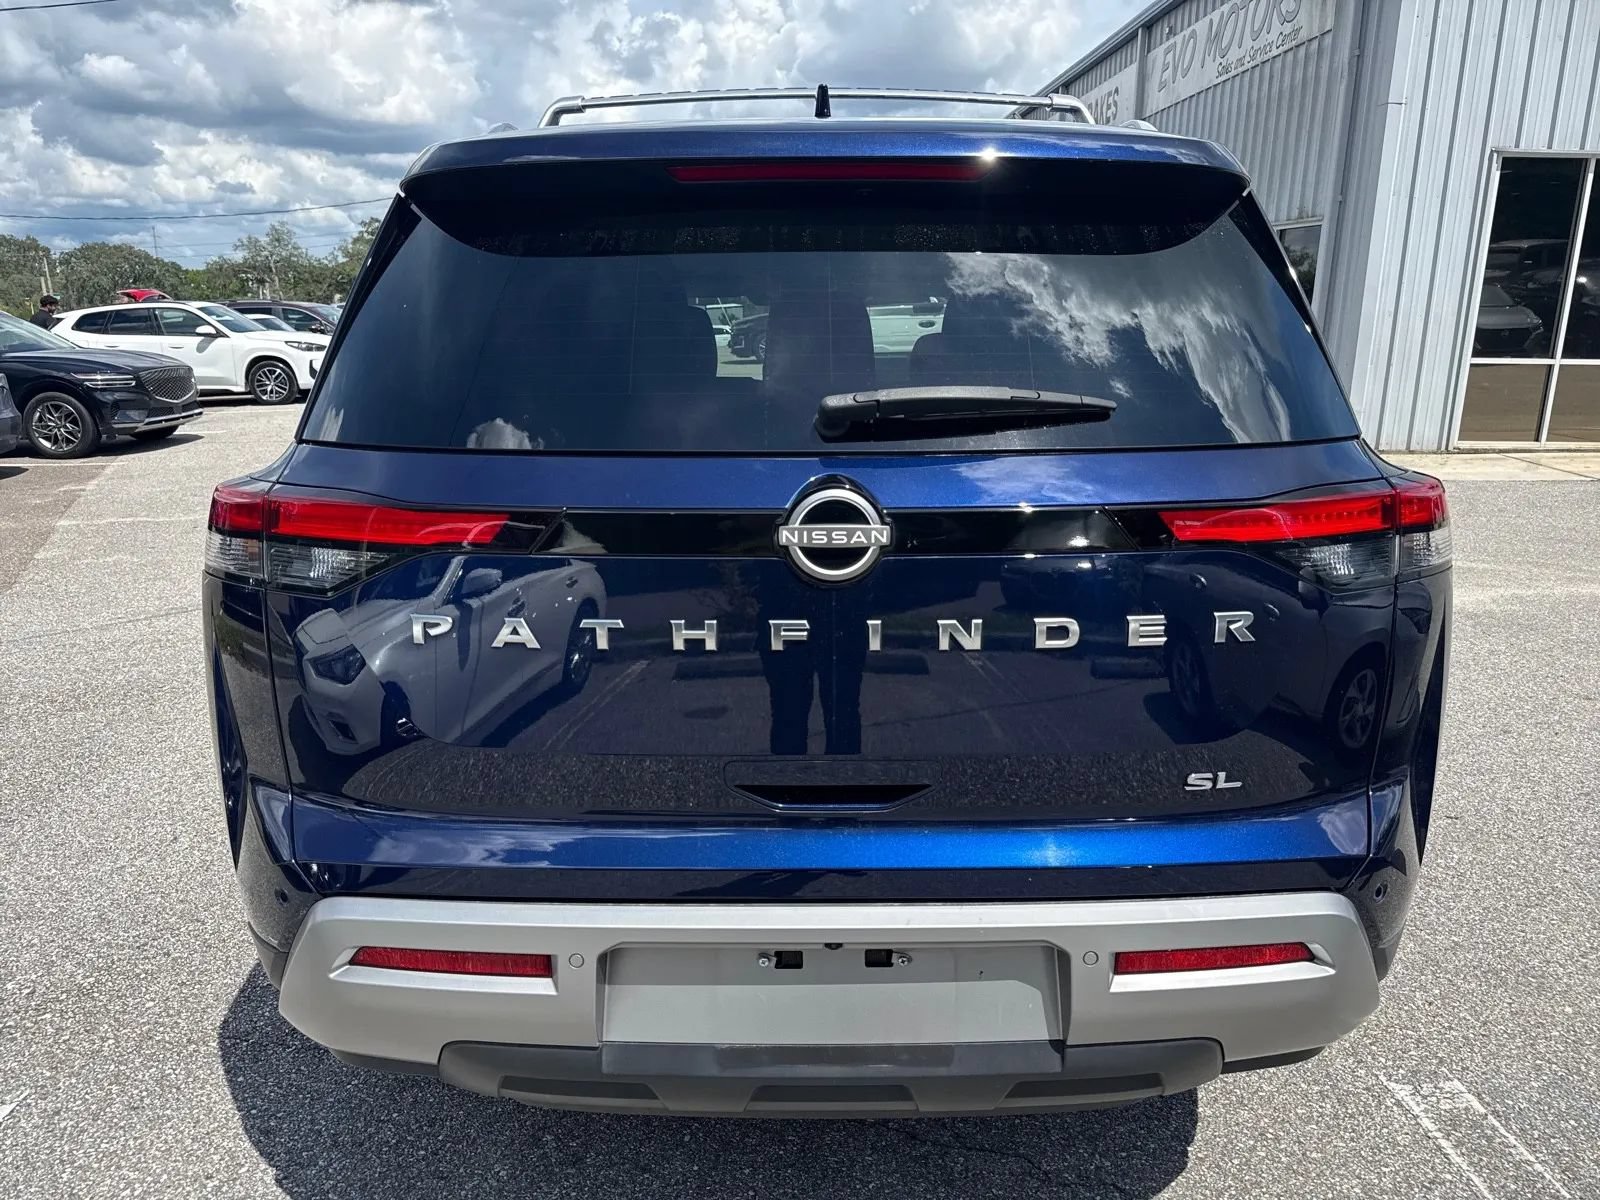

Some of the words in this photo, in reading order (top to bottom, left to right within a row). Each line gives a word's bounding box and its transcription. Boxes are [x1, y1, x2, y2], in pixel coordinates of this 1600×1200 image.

[1157, 28, 1198, 93] EVO
[1216, 58, 1234, 79] Sales
[1233, 49, 1248, 71] and
[1247, 38, 1274, 64] Service
[1276, 24, 1303, 49] Center
[782, 530, 888, 544] NISSAN
[411, 611, 1256, 651] PATHFINDER
[1184, 772, 1242, 790] SL
